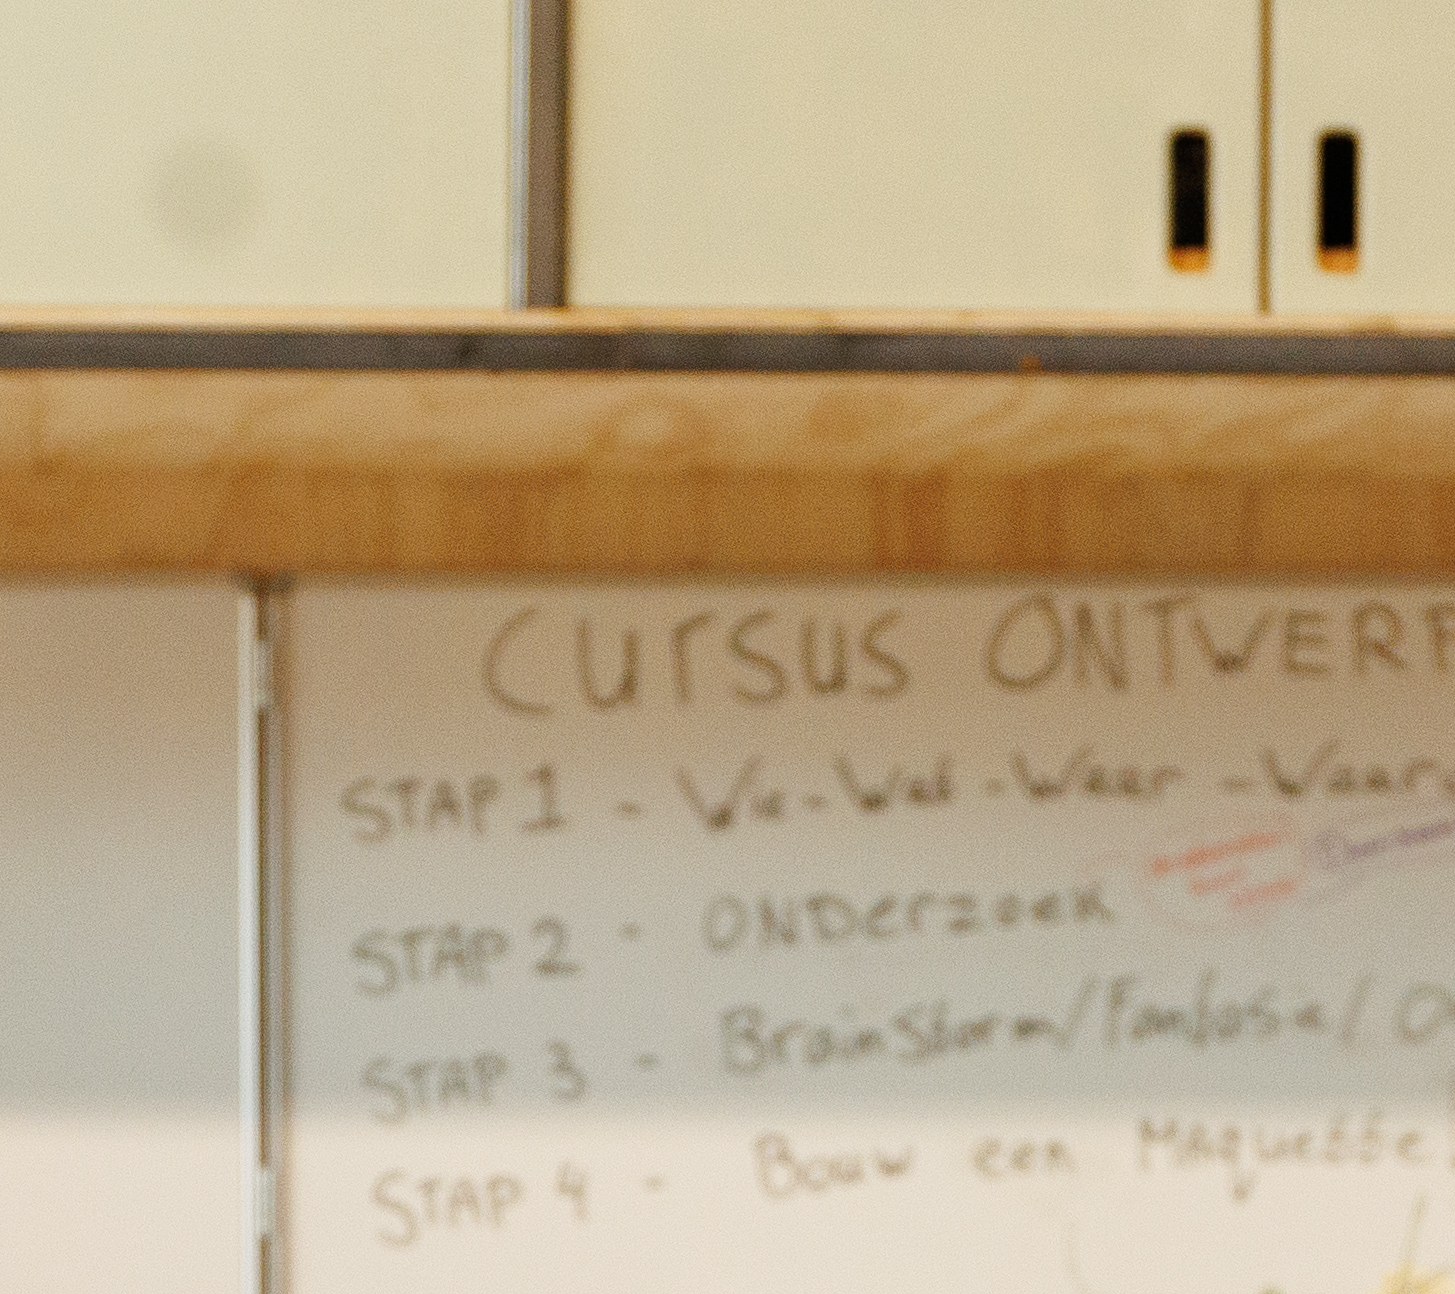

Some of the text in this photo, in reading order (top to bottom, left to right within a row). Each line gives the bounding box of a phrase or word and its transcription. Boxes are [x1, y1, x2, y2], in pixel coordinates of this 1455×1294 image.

[338, 772, 500, 846] STAP
[521, 759, 566, 833] 1
[348, 919, 510, 1000] STAP
[527, 911, 580, 980] 2
[359, 1046, 509, 1132] STAP
[543, 1035, 590, 1106] 3
[368, 1164, 525, 1253] STAP
[552, 1158, 591, 1223] 4
